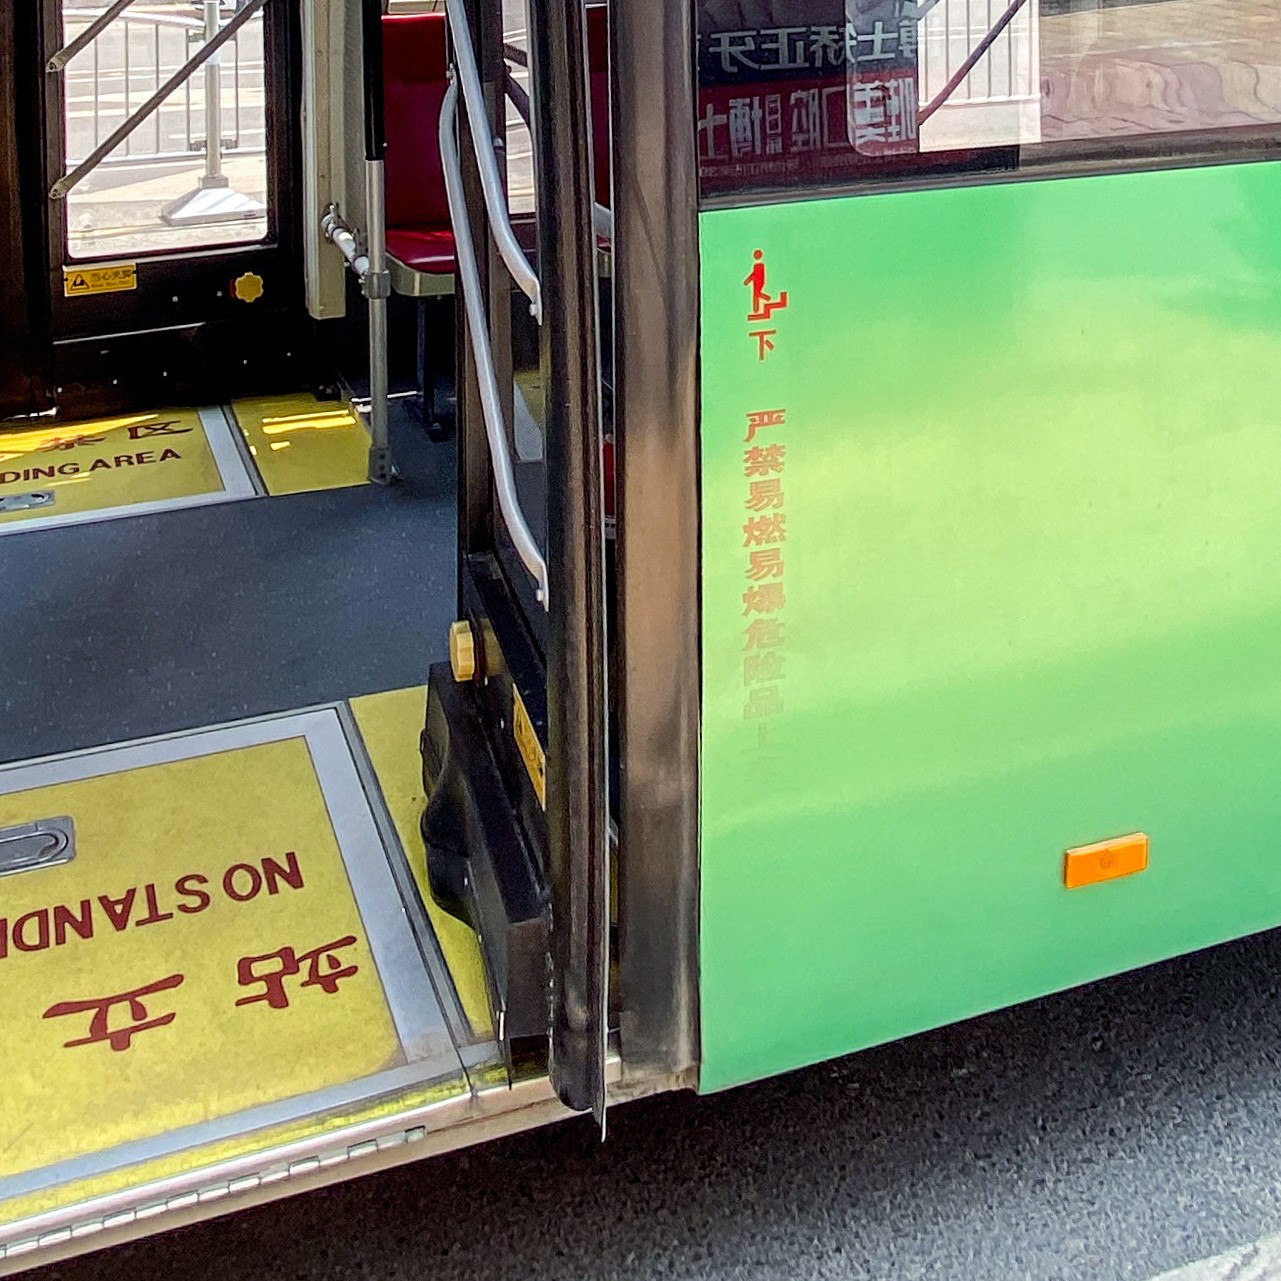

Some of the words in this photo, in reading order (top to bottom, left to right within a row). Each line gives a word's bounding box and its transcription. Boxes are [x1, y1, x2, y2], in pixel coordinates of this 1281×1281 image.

[749, 330, 777, 361] 下
[89, 448, 182, 472] AREA
[222, 851, 305, 902] NO
